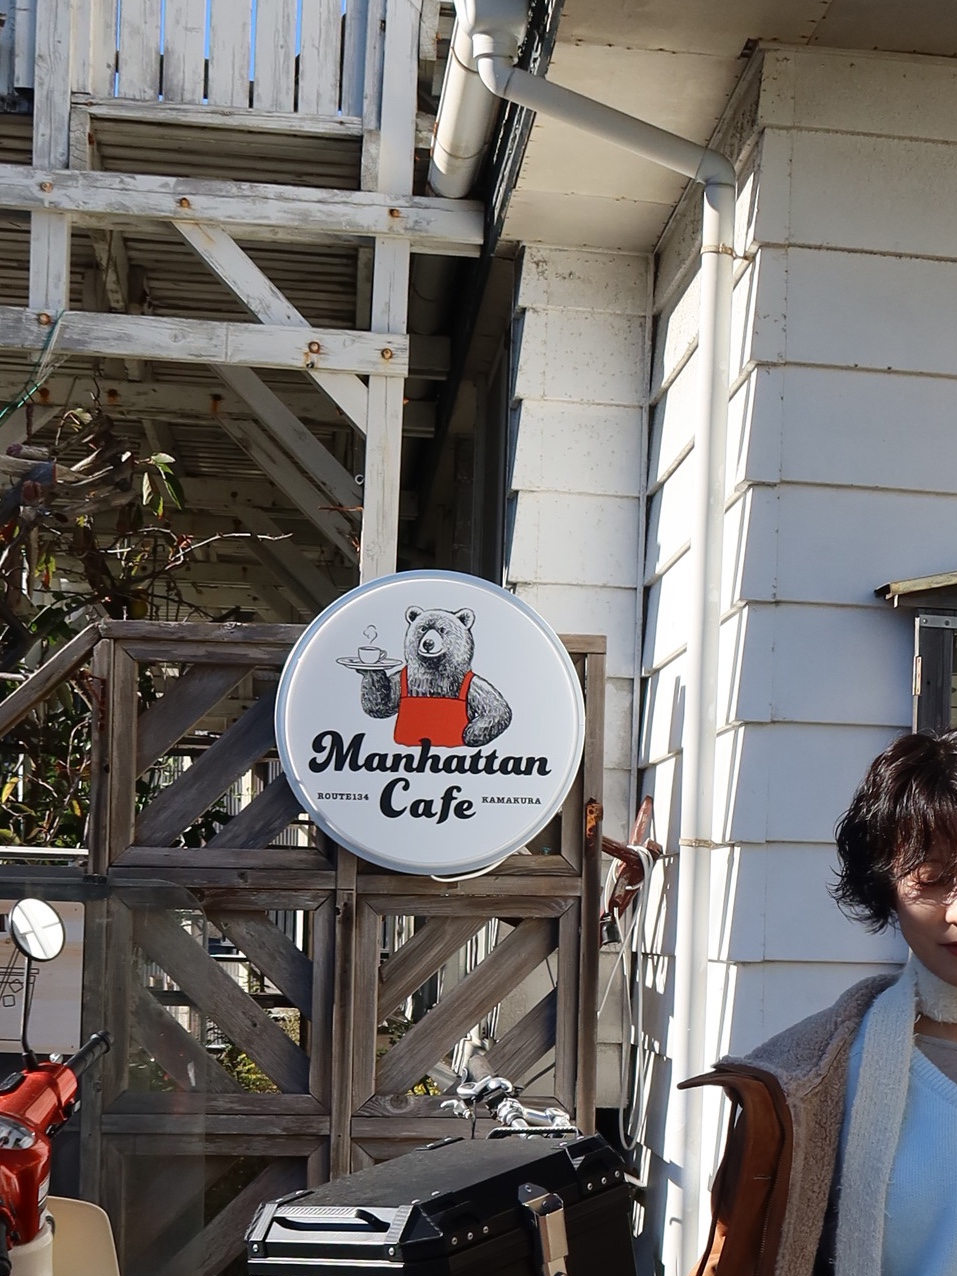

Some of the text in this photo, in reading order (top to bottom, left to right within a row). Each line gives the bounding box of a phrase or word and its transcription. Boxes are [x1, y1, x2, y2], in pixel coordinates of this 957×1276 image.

[308, 730, 552, 776] Manhattan
[317, 792, 370, 801] ROUTE134
[379, 777, 477, 824] Cafe
[481, 796, 542, 805] KAMAKURA
